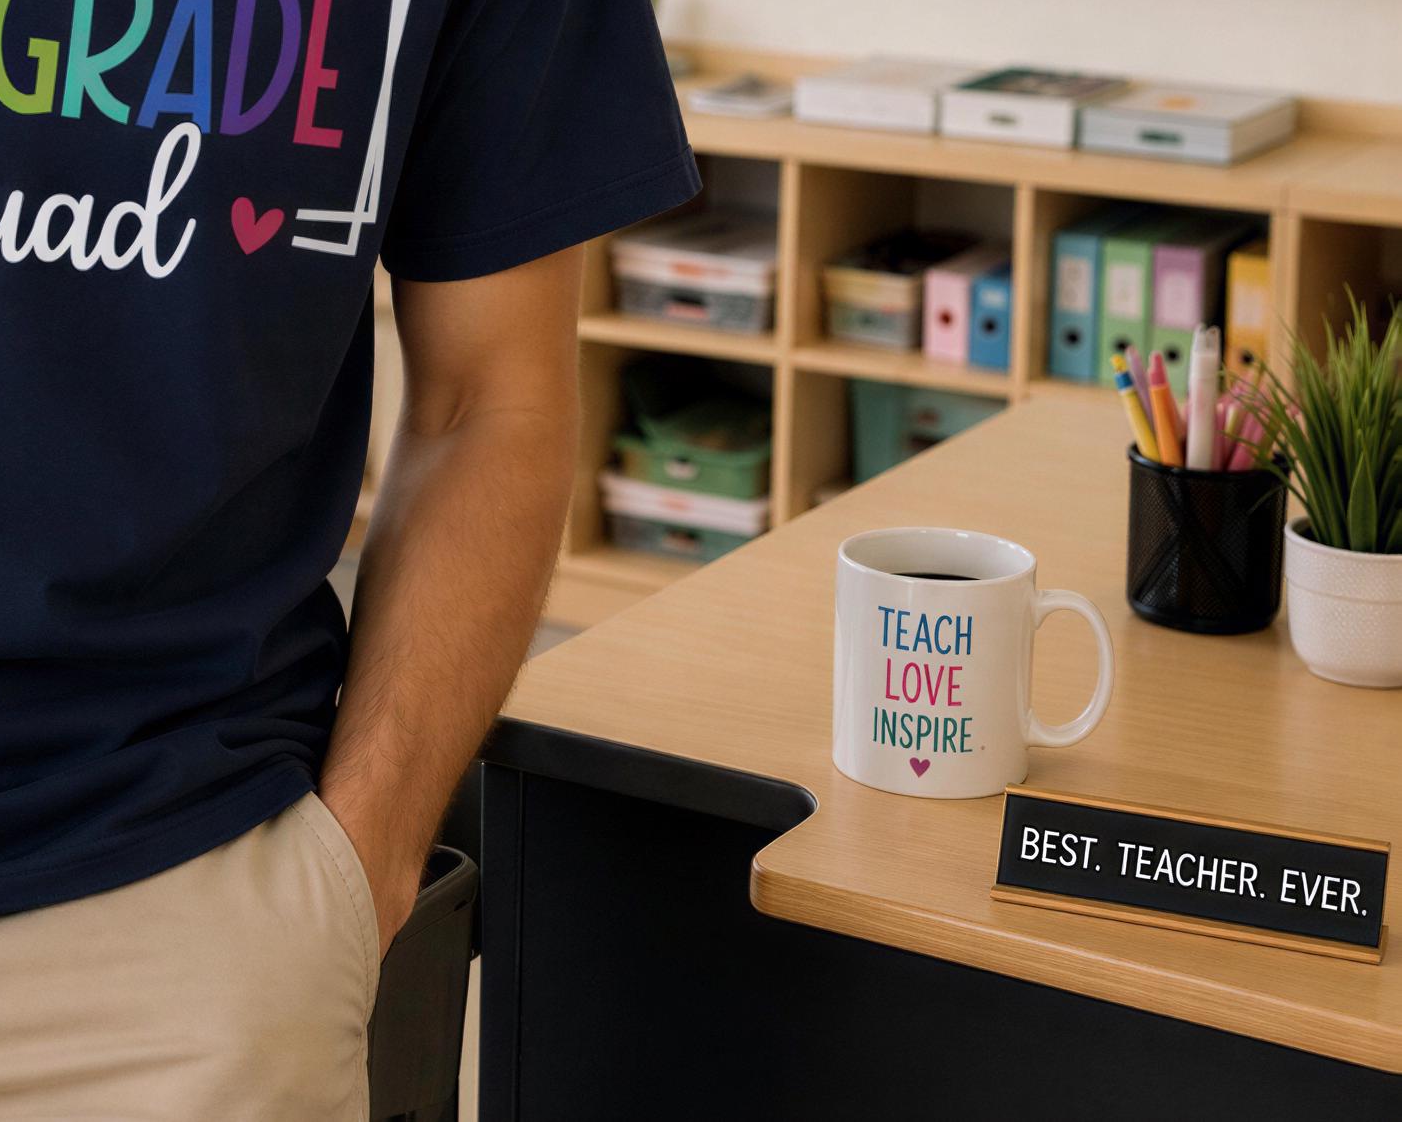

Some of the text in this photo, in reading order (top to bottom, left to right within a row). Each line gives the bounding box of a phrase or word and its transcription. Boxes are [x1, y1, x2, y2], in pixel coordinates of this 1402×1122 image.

[877, 605, 973, 656] TEACH
[885, 658, 963, 707] LOVE
[1020, 826, 1369, 918] BEST. TEACHER. EVER.
